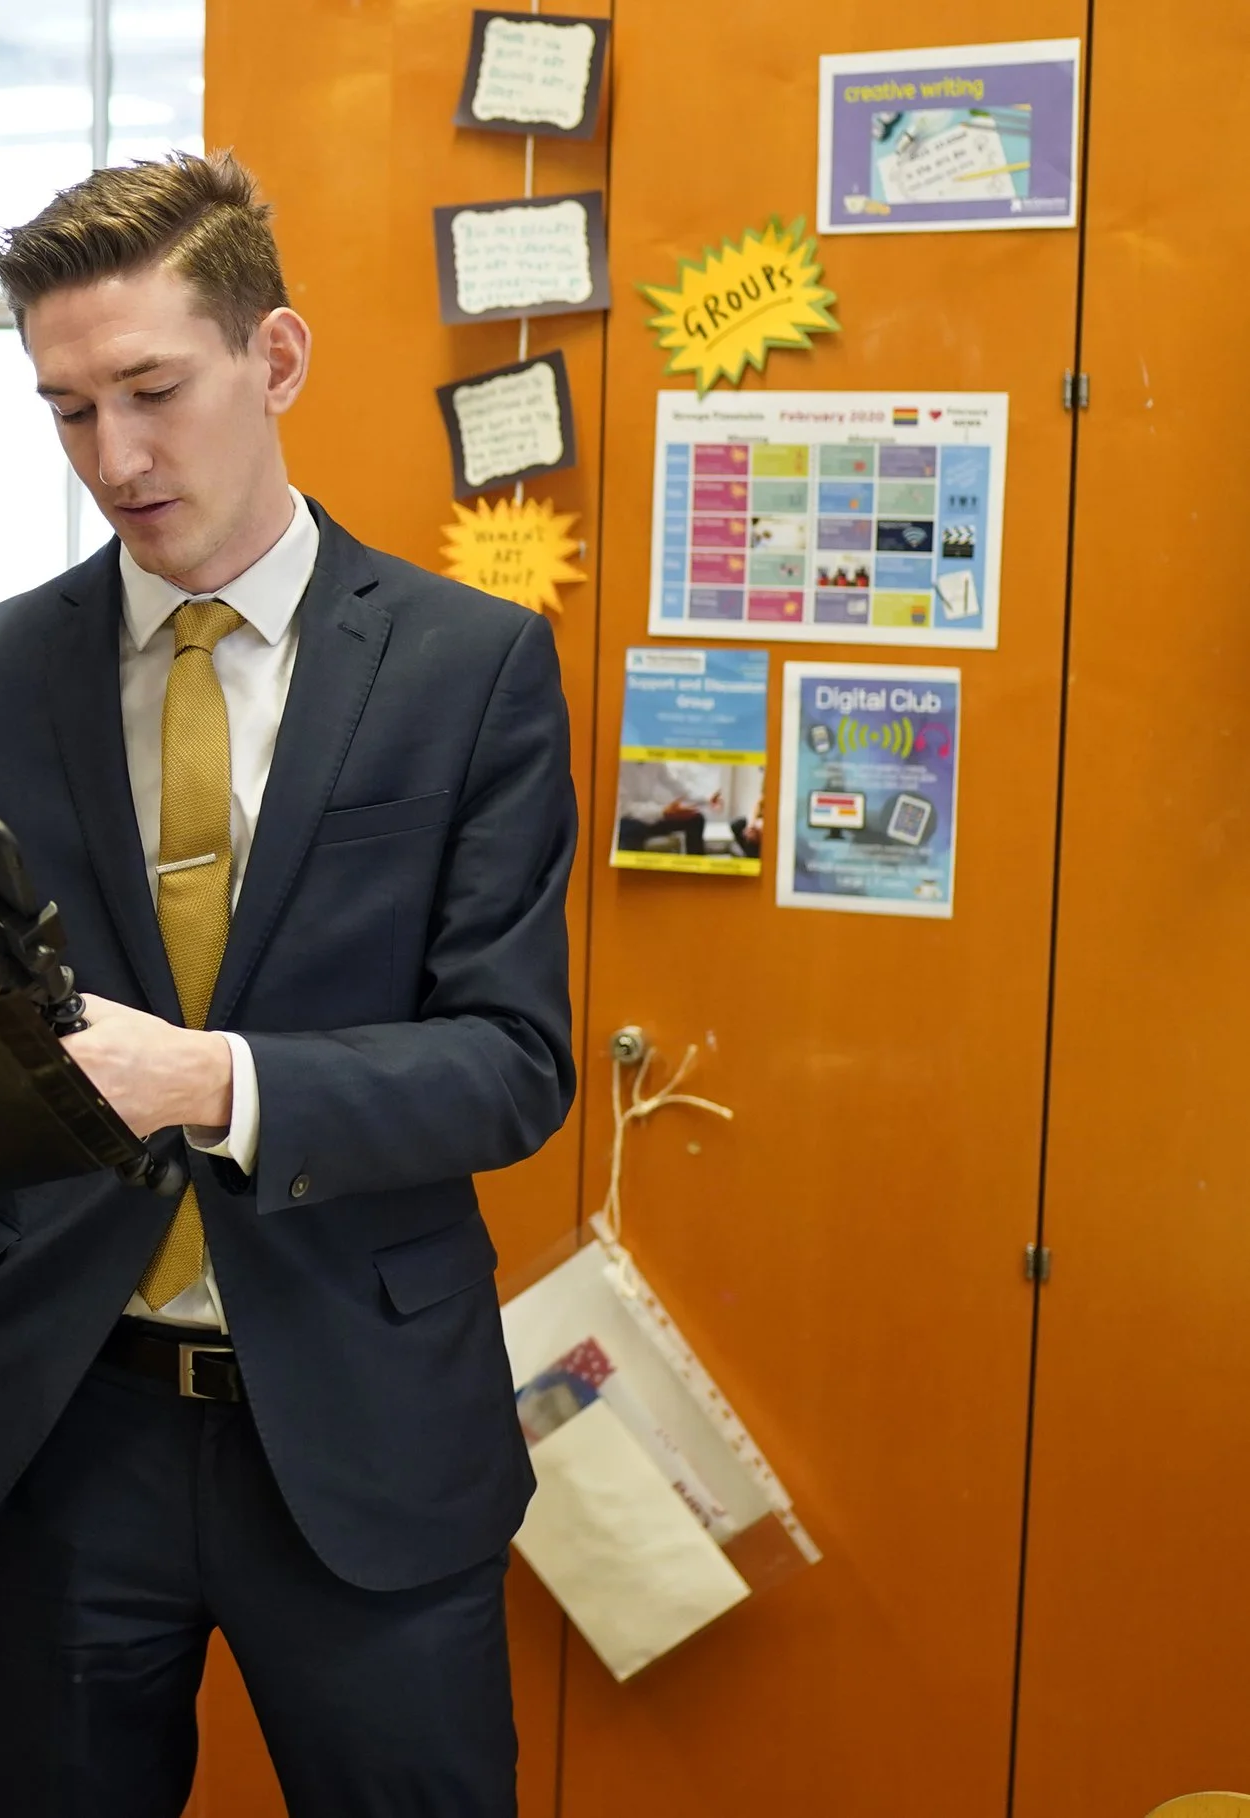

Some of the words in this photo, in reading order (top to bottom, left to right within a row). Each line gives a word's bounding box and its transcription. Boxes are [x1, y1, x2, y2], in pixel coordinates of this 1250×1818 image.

[844, 78, 917, 103] creative
[919, 75, 985, 101] writing
[779, 410, 844, 425] February
[849, 410, 885, 423] 2020
[493, 548, 522, 565] ART
[478, 568, 535, 587] GROUP
[628, 675, 676, 692] Support
[678, 677, 702, 691] and
[675, 693, 716, 711] Group
[815, 684, 887, 714] Digital
[889, 687, 942, 715] Club
